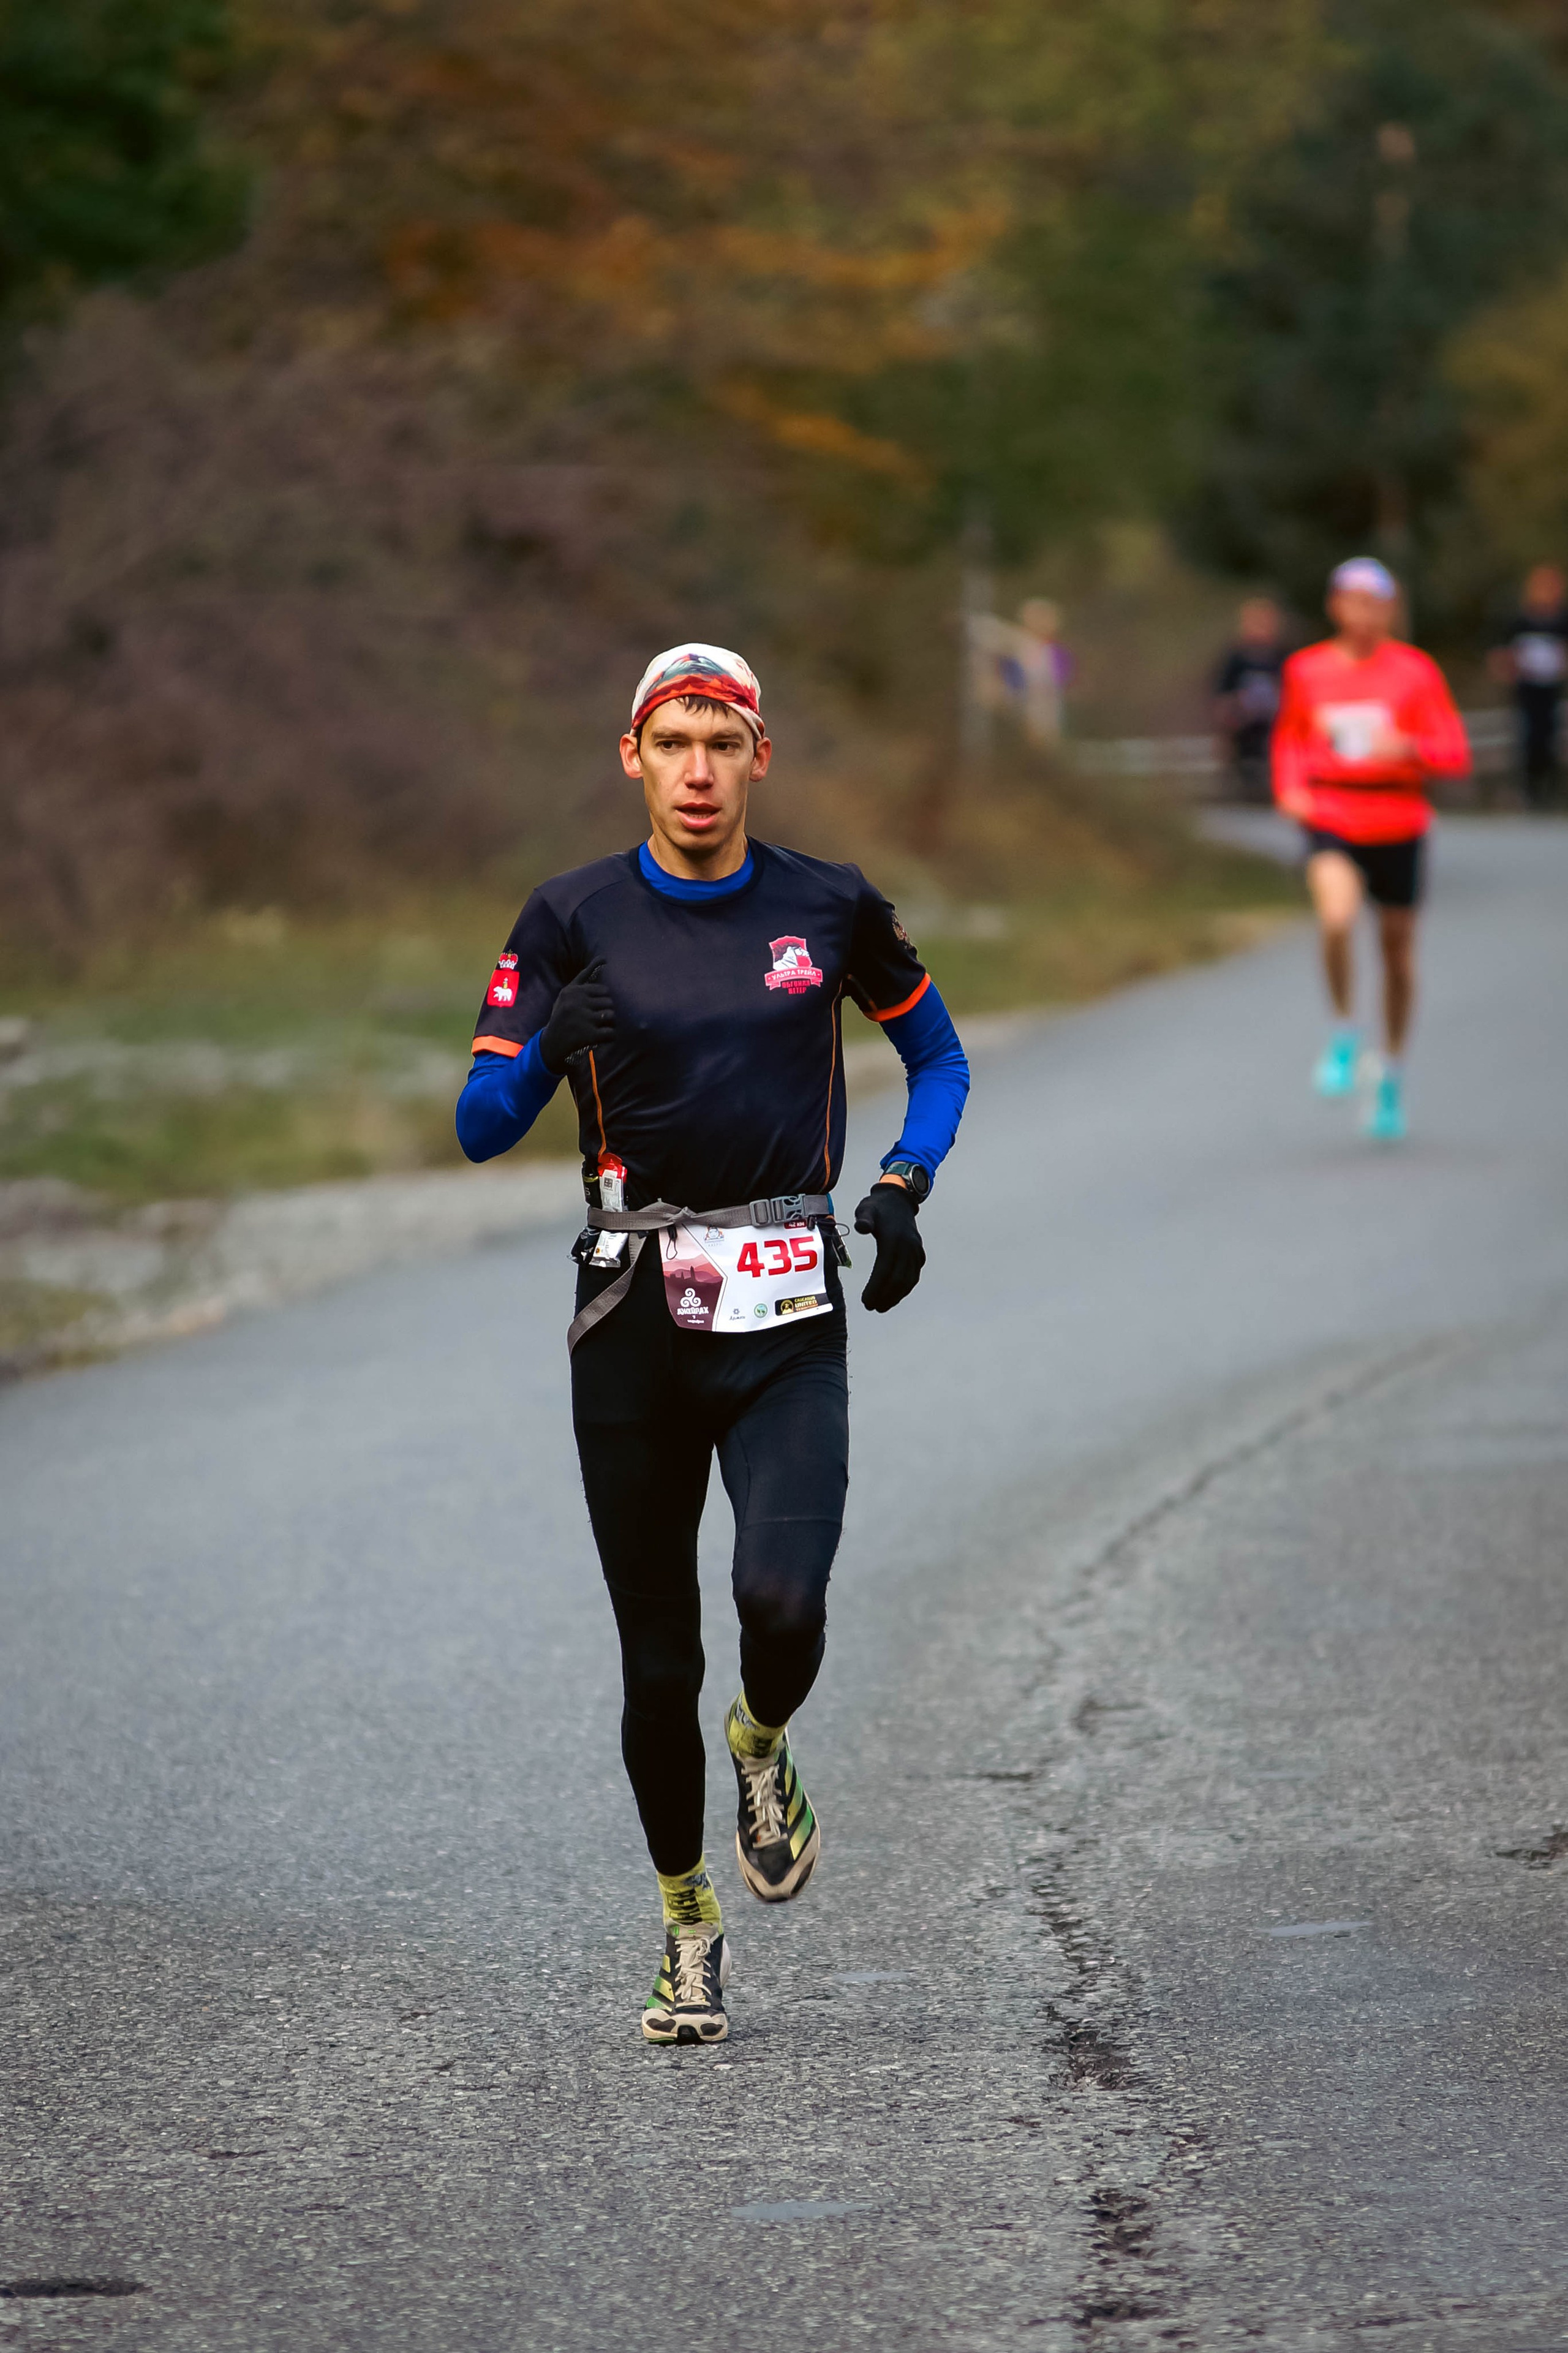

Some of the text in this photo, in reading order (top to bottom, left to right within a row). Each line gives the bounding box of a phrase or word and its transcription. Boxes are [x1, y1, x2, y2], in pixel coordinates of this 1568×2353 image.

[772, 970, 796, 980] УЛЬТРА
[737, 1236, 818, 1278] 435
[794, 1299, 817, 1308] UNITED
